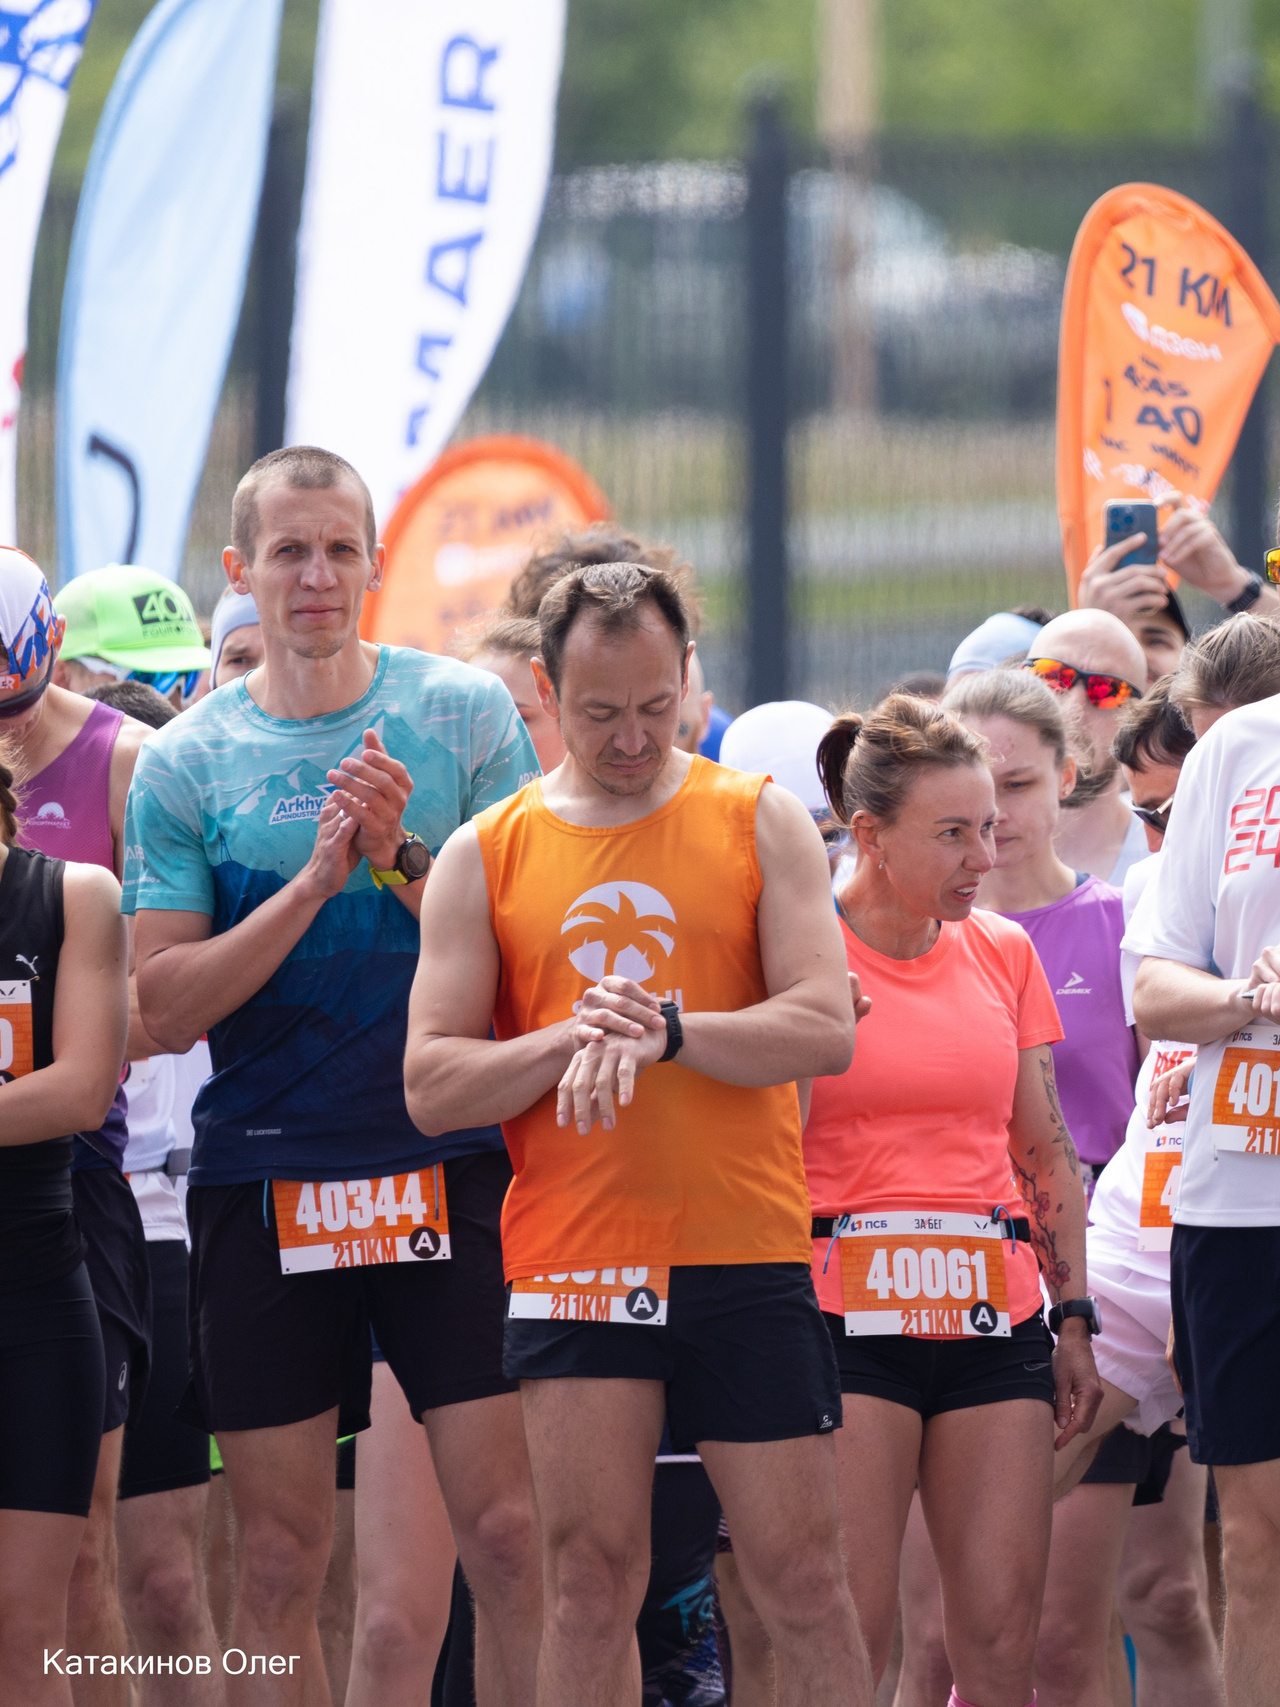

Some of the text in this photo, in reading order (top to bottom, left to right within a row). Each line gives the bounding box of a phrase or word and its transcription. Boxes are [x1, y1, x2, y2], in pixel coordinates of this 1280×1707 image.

[1121, 243, 1155, 297] 21
[1239, 1033, 1252, 1041] ПСБ
[296, 1173, 427, 1234] 40344
[865, 1220, 888, 1229] ПСБ
[414, 1231, 435, 1251] A
[866, 1247, 988, 1300] 40061
[631, 1292, 653, 1313] A
[974, 1307, 993, 1327] A
